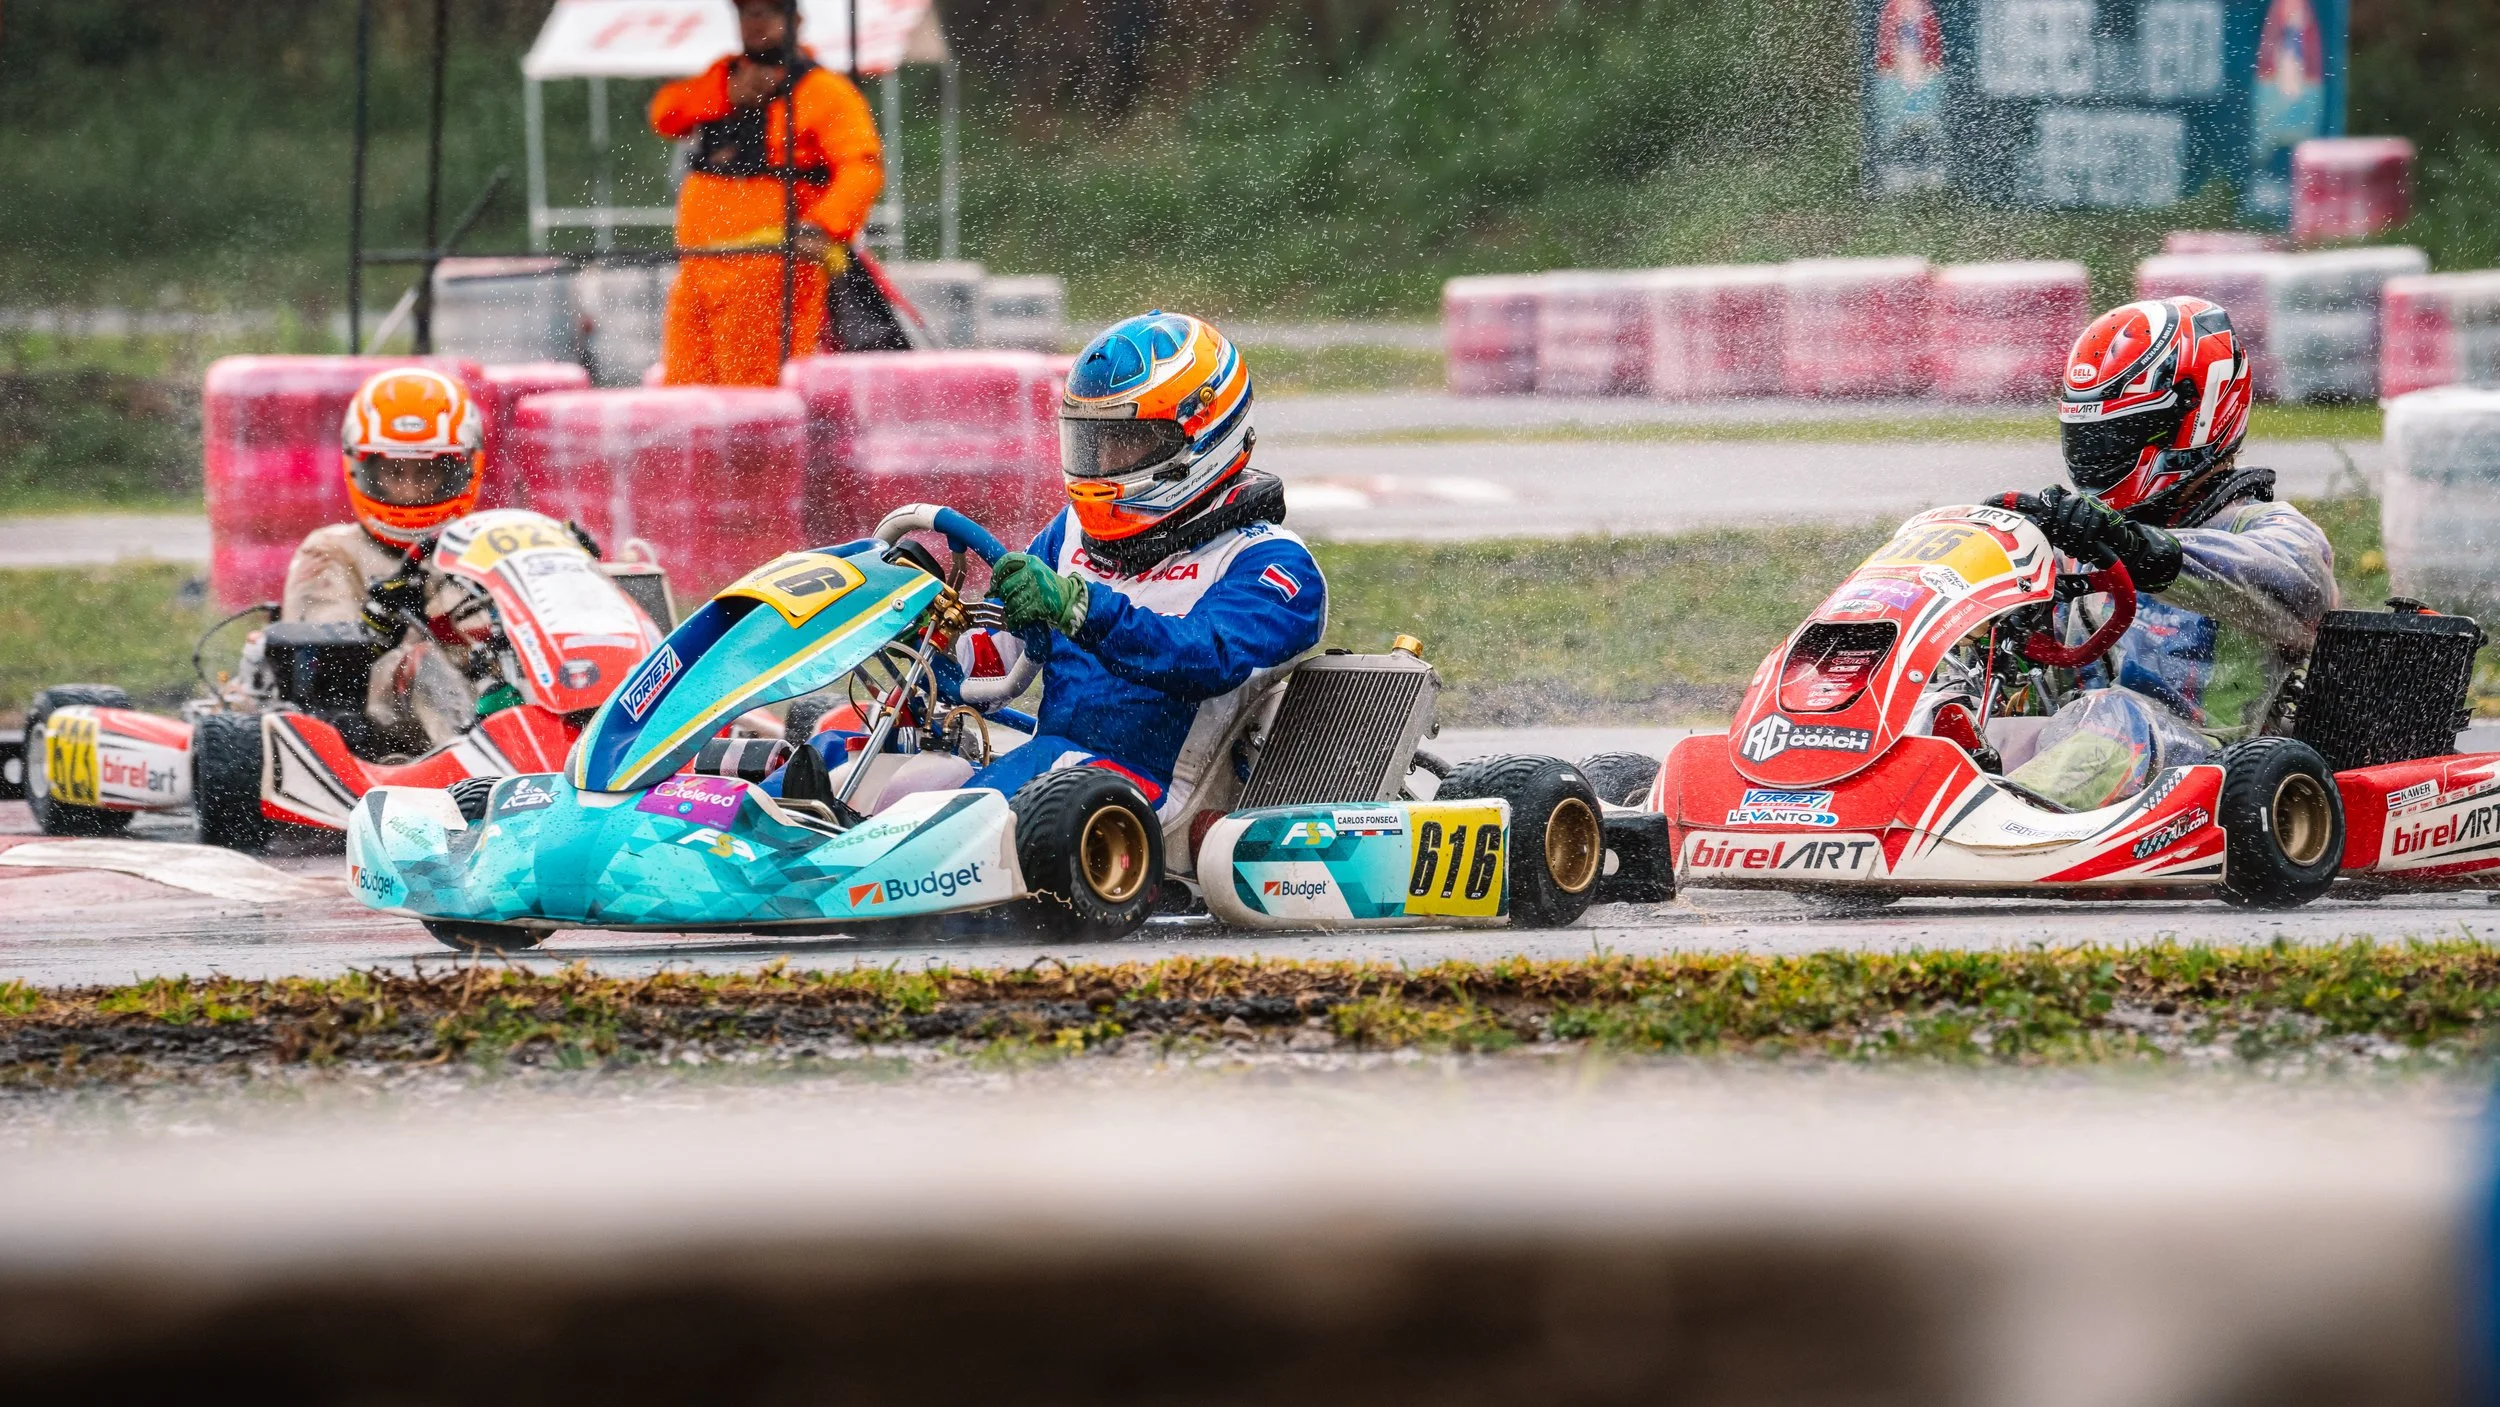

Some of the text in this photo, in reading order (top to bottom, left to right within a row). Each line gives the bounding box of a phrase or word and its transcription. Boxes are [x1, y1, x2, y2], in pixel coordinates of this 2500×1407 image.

[2141, 338, 2165, 366] RICHARD
[2072, 368, 2092, 377] BELL
[623, 651, 671, 716] VORTEX
[1789, 734, 1868, 750] COACH
[1793, 727, 1870, 738] ALEX RG
[103, 754, 177, 794] birelart
[676, 786, 737, 808] telered
[1743, 791, 1829, 806] VORTEX
[2400, 783, 2431, 800] KAWER
[1337, 816, 1399, 824] CARLOS FONSECA
[1728, 812, 1813, 823] LEVANTO
[1409, 820, 1502, 901] 616
[1690, 838, 1876, 869] birelART
[360, 867, 396, 900] Budget
[885, 862, 983, 901] Budget
[1281, 880, 1327, 900] Budget
